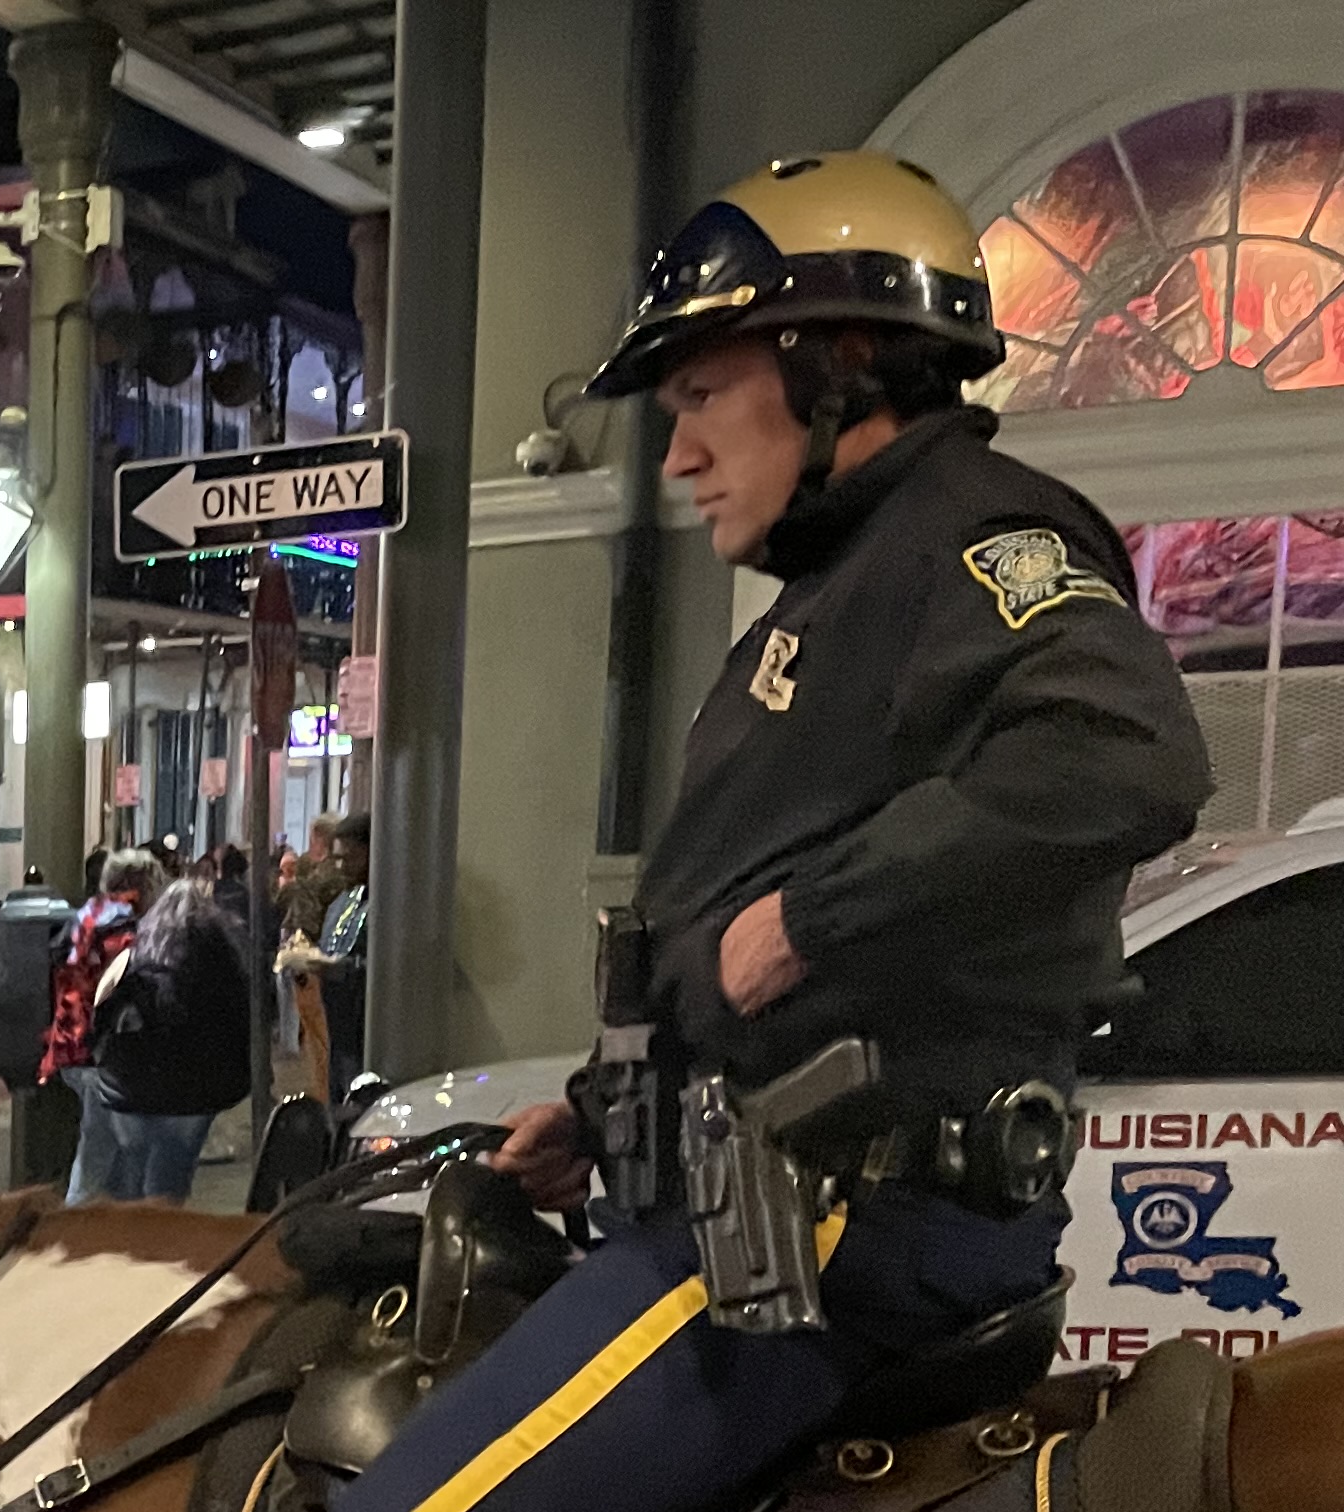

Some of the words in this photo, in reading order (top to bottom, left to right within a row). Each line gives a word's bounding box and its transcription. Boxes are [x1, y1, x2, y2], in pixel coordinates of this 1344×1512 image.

[202, 478, 275, 519] ONE
[292, 466, 372, 509] WAY
[1006, 579, 1057, 610] STATE
[1076, 1112, 1344, 1150] UISIANA
